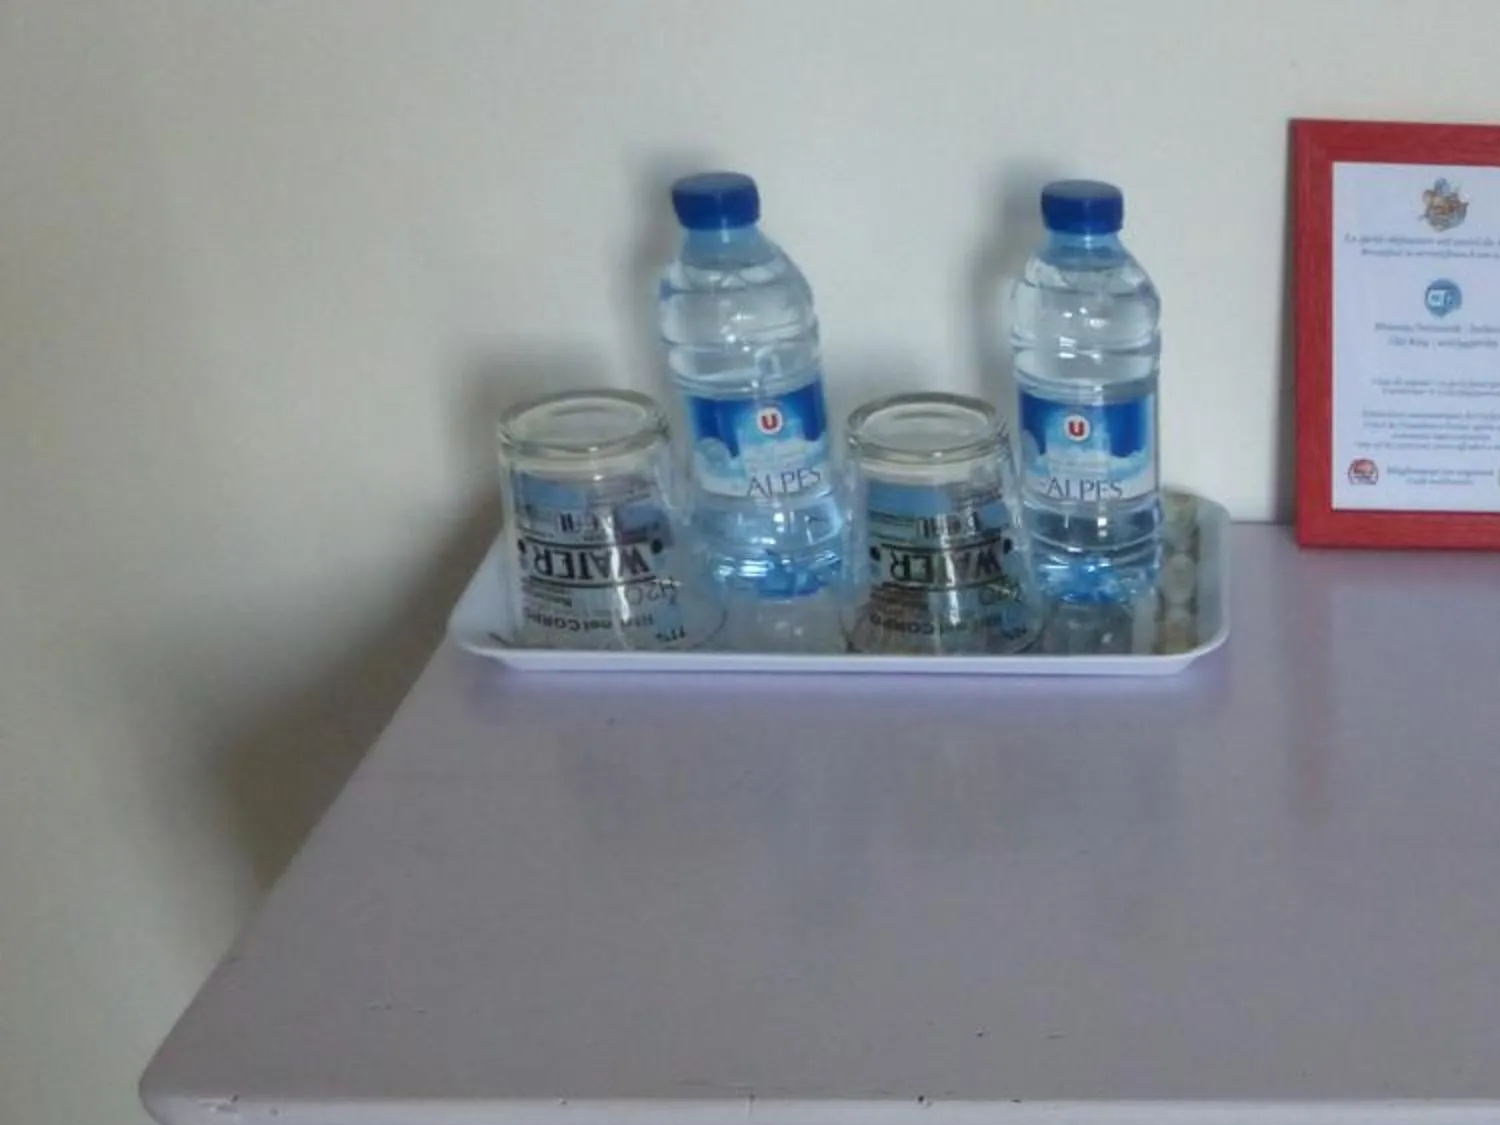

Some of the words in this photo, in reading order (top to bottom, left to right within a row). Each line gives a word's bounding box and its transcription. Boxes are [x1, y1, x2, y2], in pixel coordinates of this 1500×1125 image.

[760, 413, 779, 431] U
[1067, 419, 1086, 438] U
[1047, 477, 1124, 501] ALPES
[533, 545, 651, 580] WATER
[890, 549, 1003, 583] WAER
